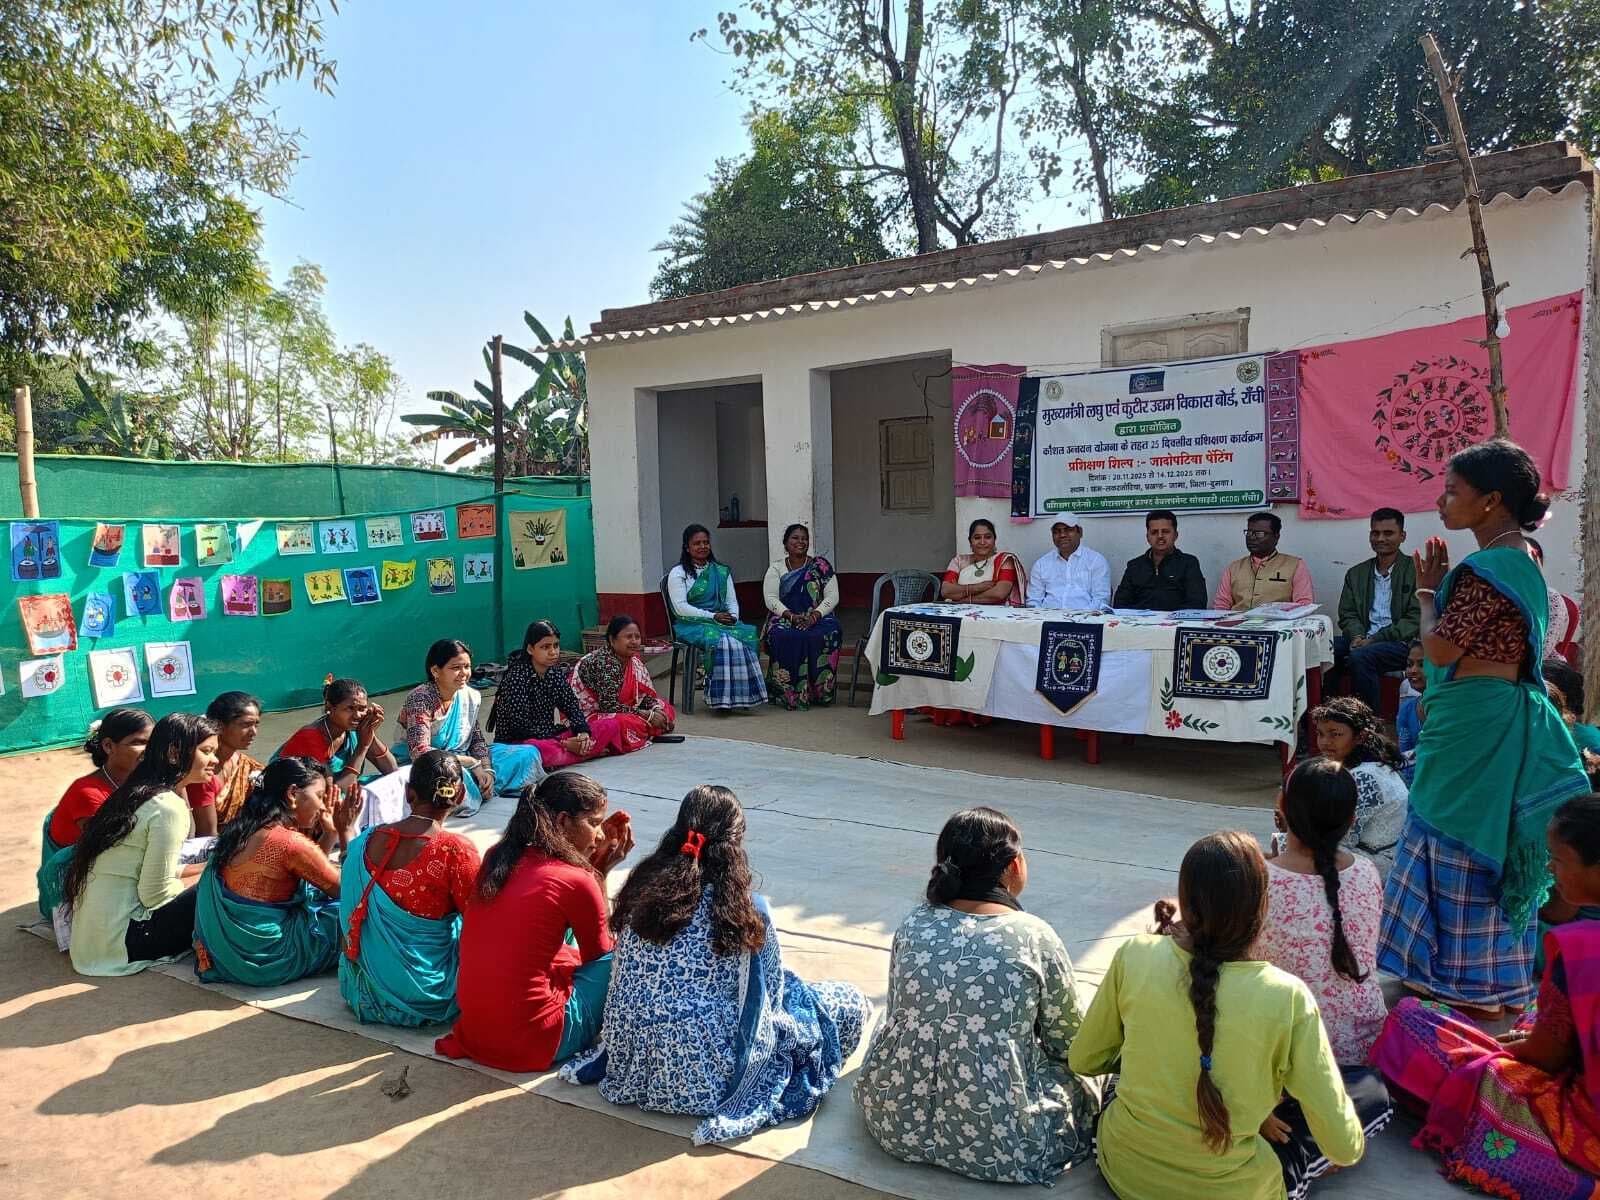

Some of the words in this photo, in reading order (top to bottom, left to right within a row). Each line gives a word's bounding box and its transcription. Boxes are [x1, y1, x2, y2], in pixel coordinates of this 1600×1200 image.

[1042, 402, 1084, 425] मुख्यमंत्री
[1086, 404, 1104, 421] लघु
[1105, 398, 1120, 416] एवं
[1121, 397, 1149, 419] कुटीर
[1150, 398, 1175, 413] उद्यम
[1176, 393, 1213, 411] विकास
[1215, 388, 1239, 408] बोर्ड,
[1240, 386, 1264, 405] राँची
[1119, 425, 1136, 435] द्वारा
[1139, 420, 1177, 434] प्रायोजित
[1042, 443, 1064, 456] कौशल
[1094, 441, 1118, 454] योजना
[1120, 439, 1129, 451] के
[1130, 441, 1148, 451] तहत
[1151, 440, 1159, 449] 25
[1194, 433, 1228, 447] प्रशिक्षण
[1230, 430, 1264, 444] कार्यक्रम
[1068, 457, 1106, 472] प्रशिक्षण
[1108, 455, 1134, 471] शिल्प
[1150, 451, 1204, 467] जादोपटिया
[1157, 470, 1194, 478] 14.12.2025
